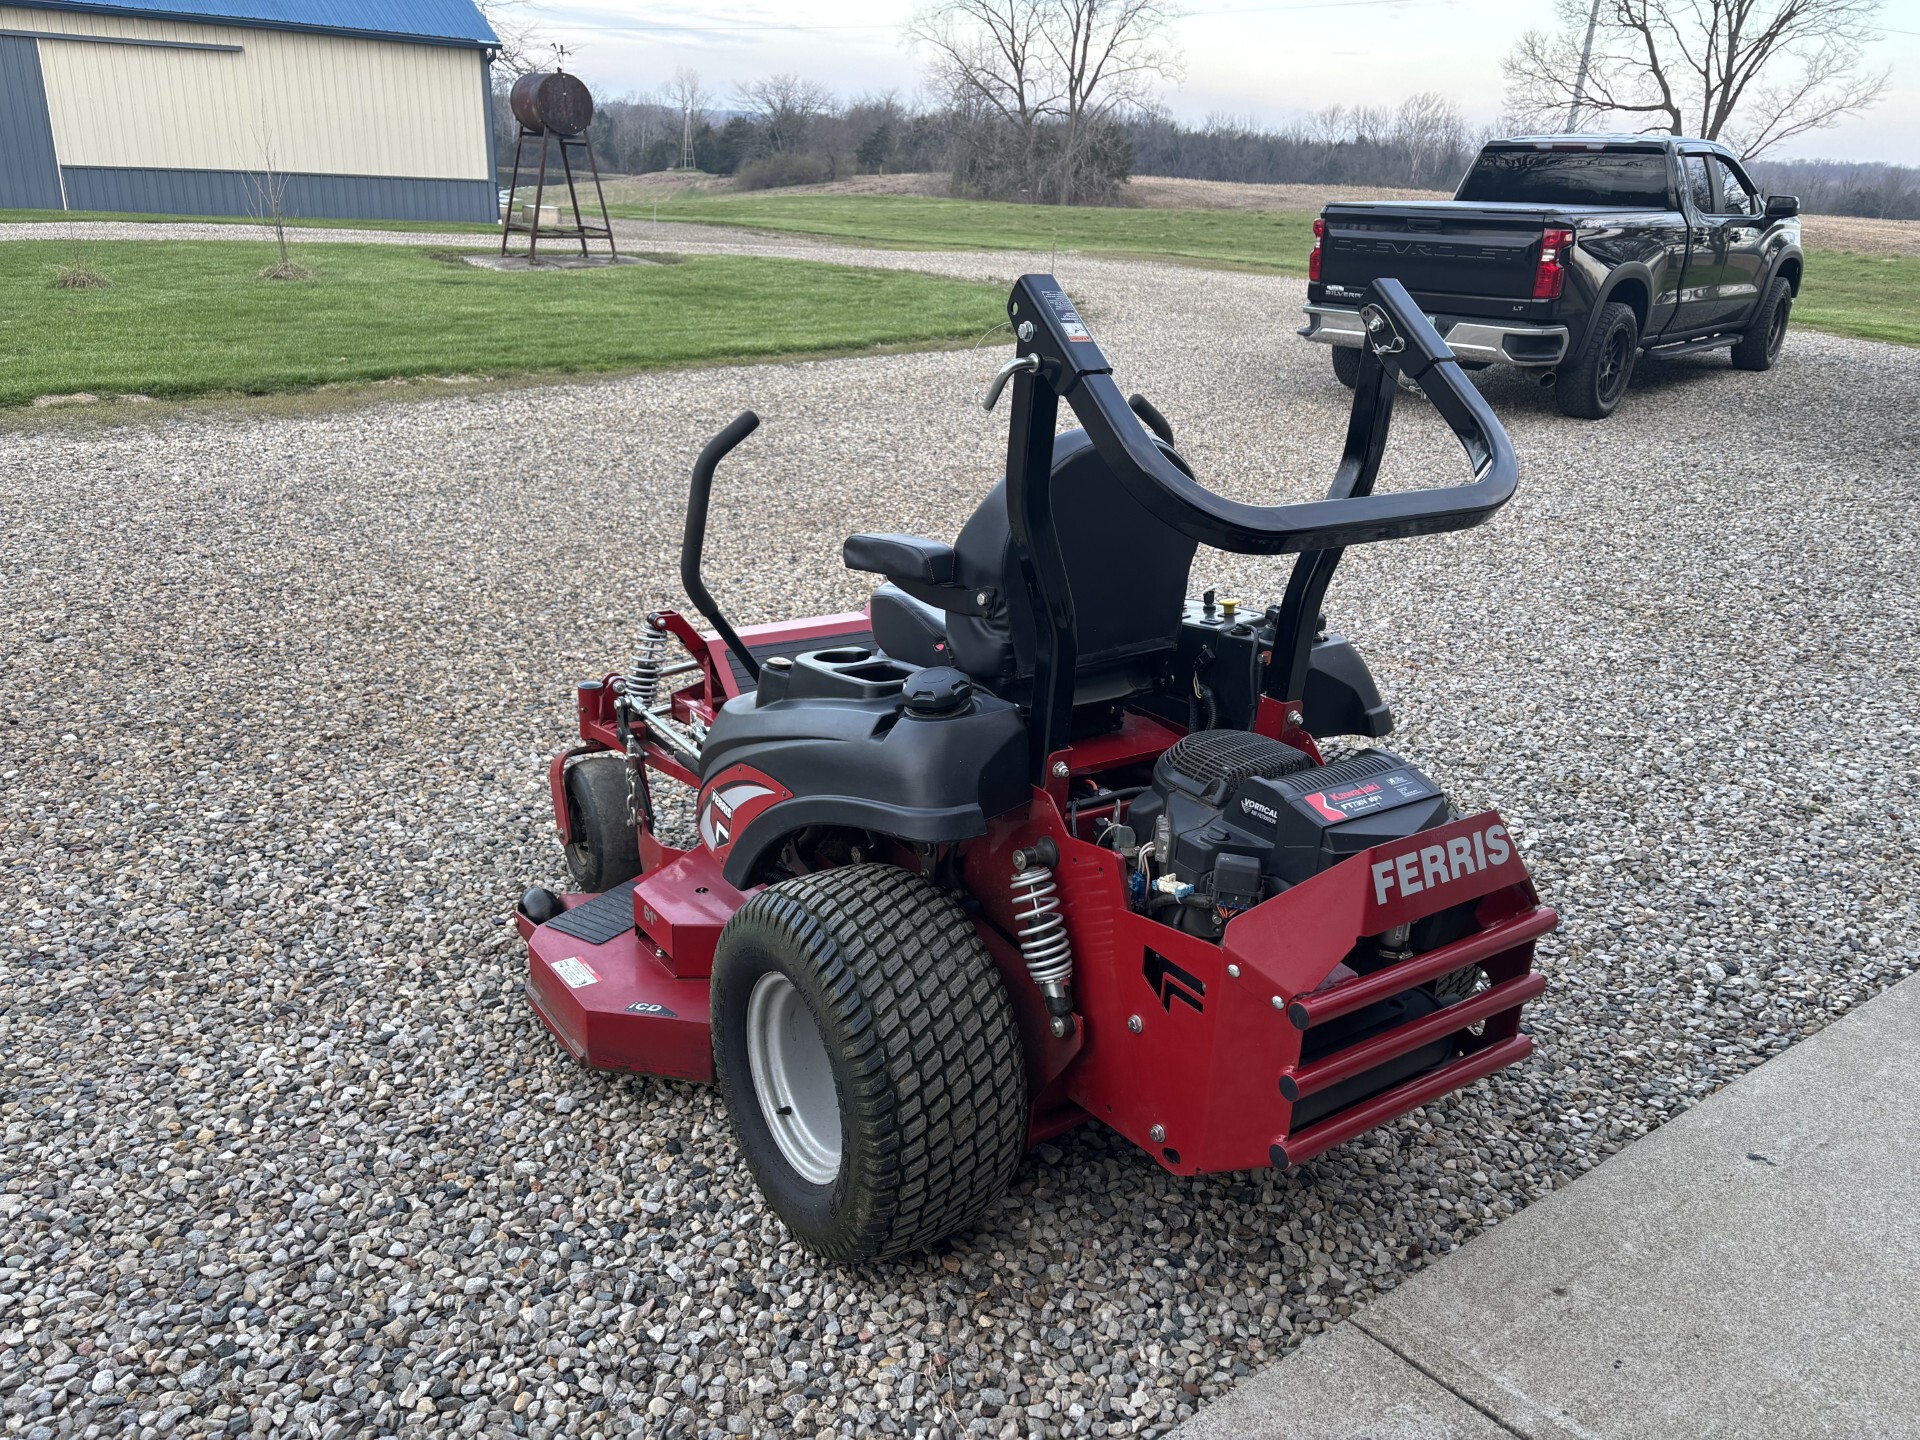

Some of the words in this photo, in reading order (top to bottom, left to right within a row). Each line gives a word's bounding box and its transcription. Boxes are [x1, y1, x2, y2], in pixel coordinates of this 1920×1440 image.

[1328, 782, 1381, 802] Kawasaki
[711, 790, 733, 819] FERRIS
[1244, 797, 1278, 819] VORTICAL
[1371, 824, 1511, 906] FERRIS
[628, 1001, 663, 1012] iCD
